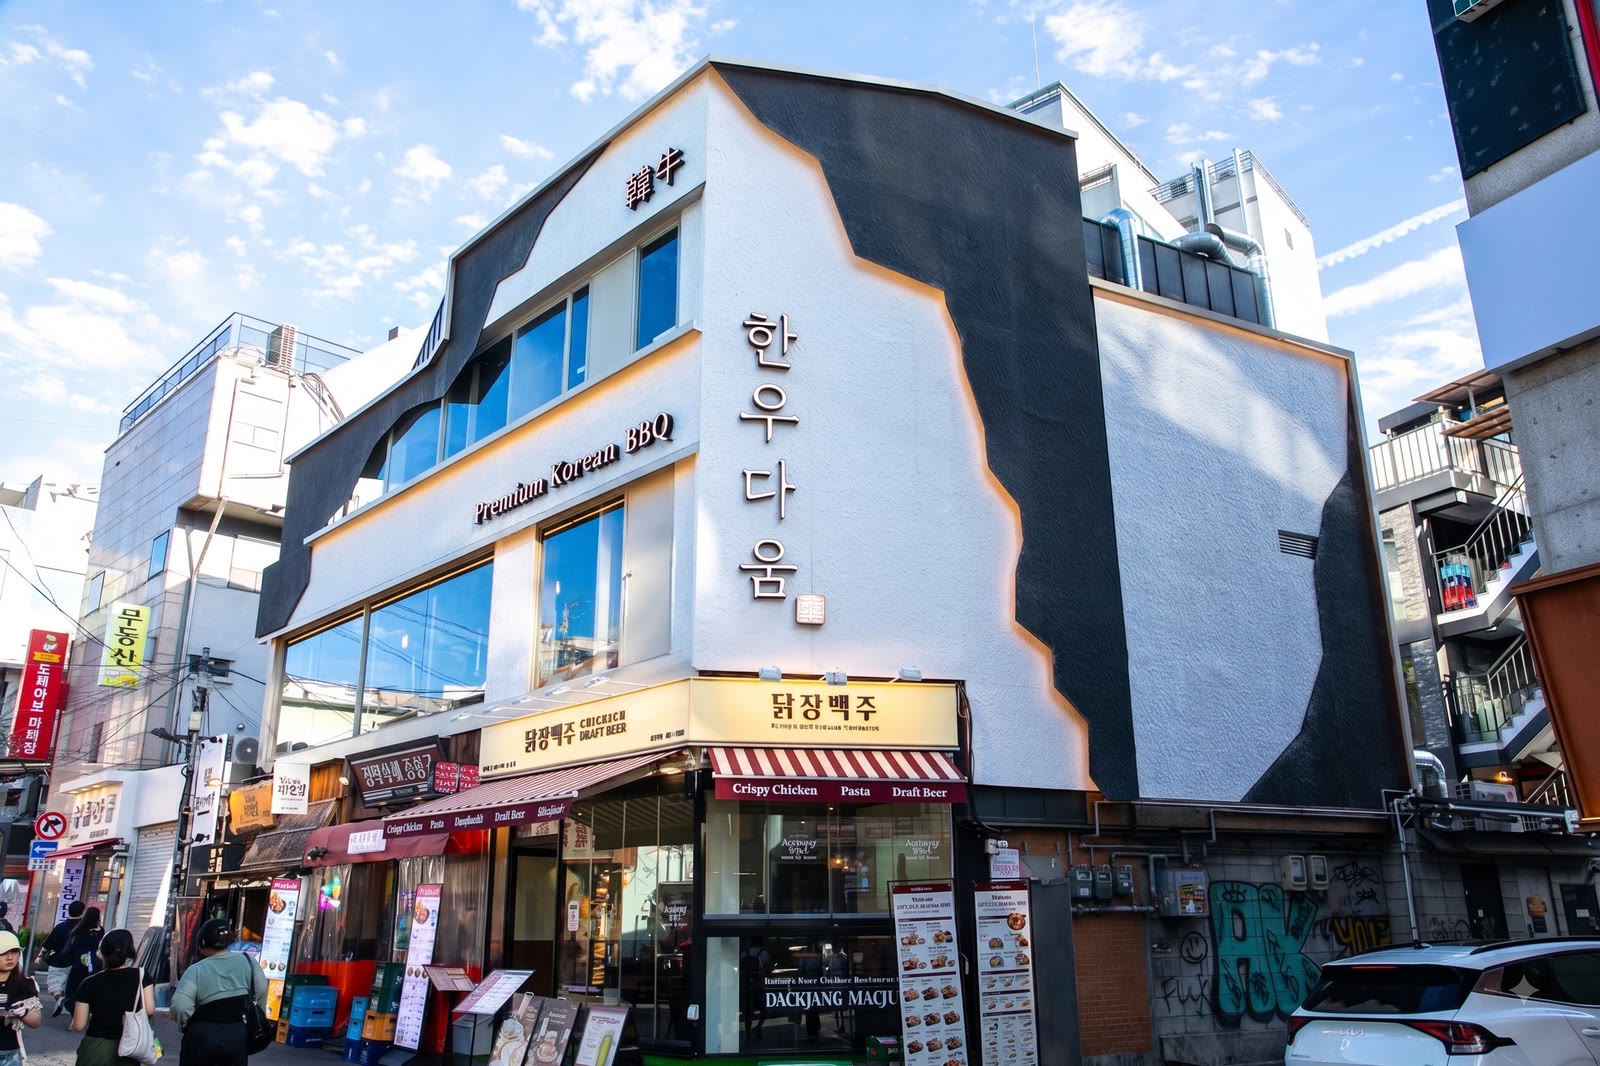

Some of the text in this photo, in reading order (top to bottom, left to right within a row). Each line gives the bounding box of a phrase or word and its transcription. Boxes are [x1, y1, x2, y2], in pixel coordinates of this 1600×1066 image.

[626, 147, 685, 211] 韓牛
[739, 313, 799, 600] 한우다움
[475, 411, 674, 525] Premium Korean BBQ
[771, 693, 877, 722] 닭장백주
[579, 722, 627, 741] DRAFT BEER
[732, 783, 818, 796] Crispy Chicken
[840, 786, 871, 797] Pasta
[892, 786, 948, 798] Draft Beer
[430, 820, 444, 830] Pasta
[765, 990, 843, 1010] DACKJANG
